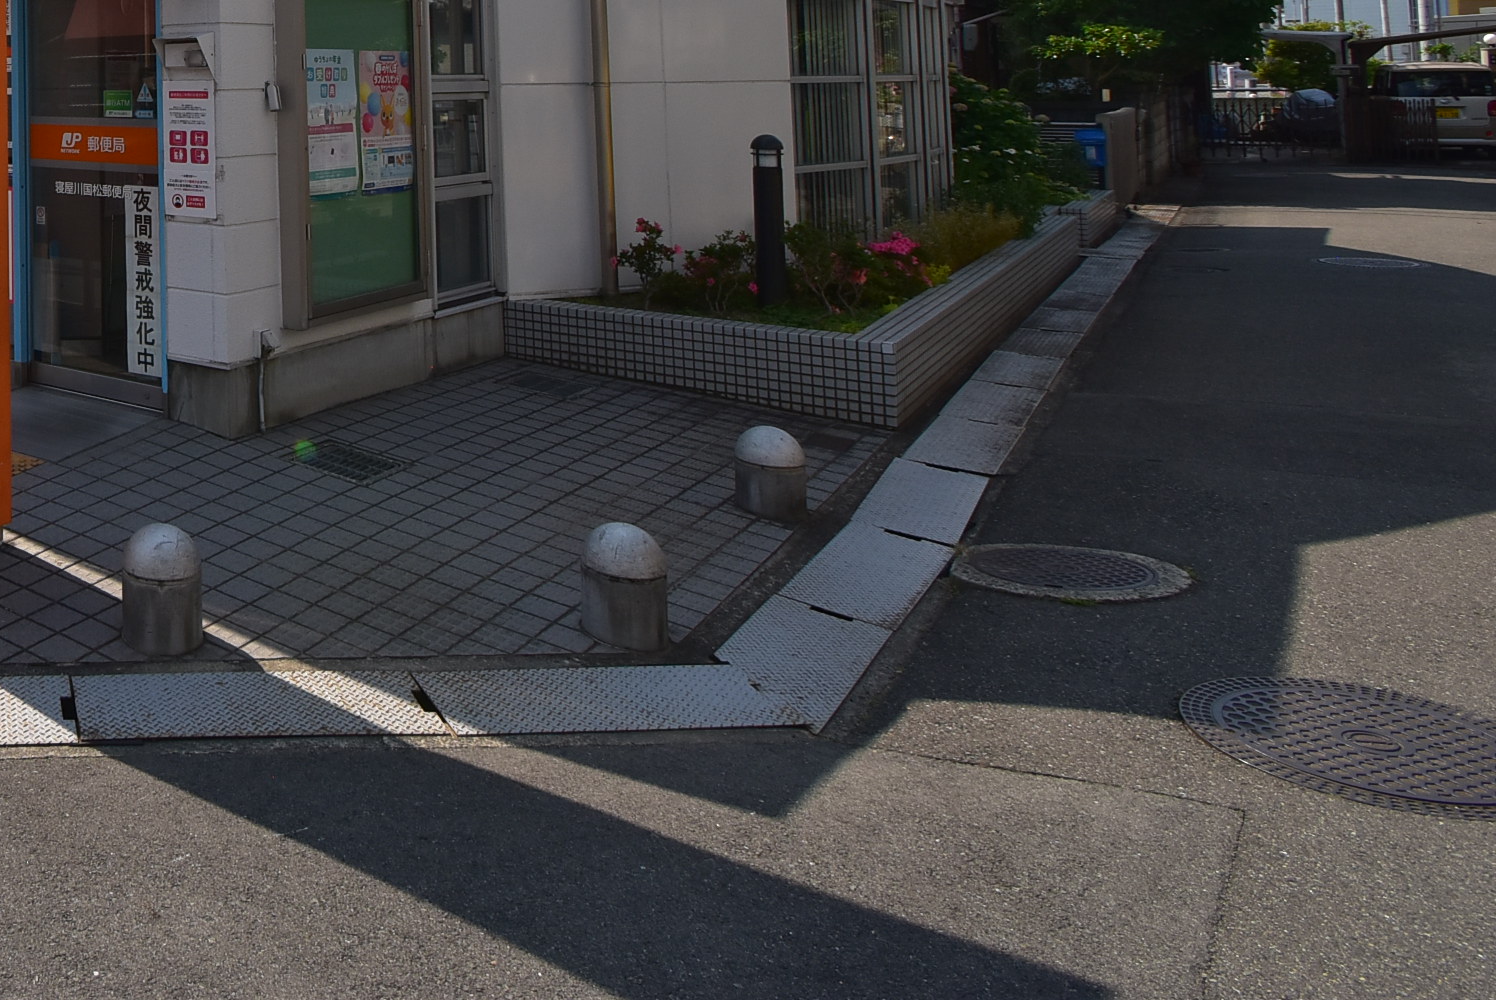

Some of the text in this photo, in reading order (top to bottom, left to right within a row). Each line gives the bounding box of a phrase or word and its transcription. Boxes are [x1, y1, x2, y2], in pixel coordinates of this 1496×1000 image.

[61, 132, 82, 148] JP
[87, 136, 125, 154] 郵便局
[55, 180, 132, 200] 寝屋川国松郵便局
[133, 188, 156, 373] 夜間警戒強化中
